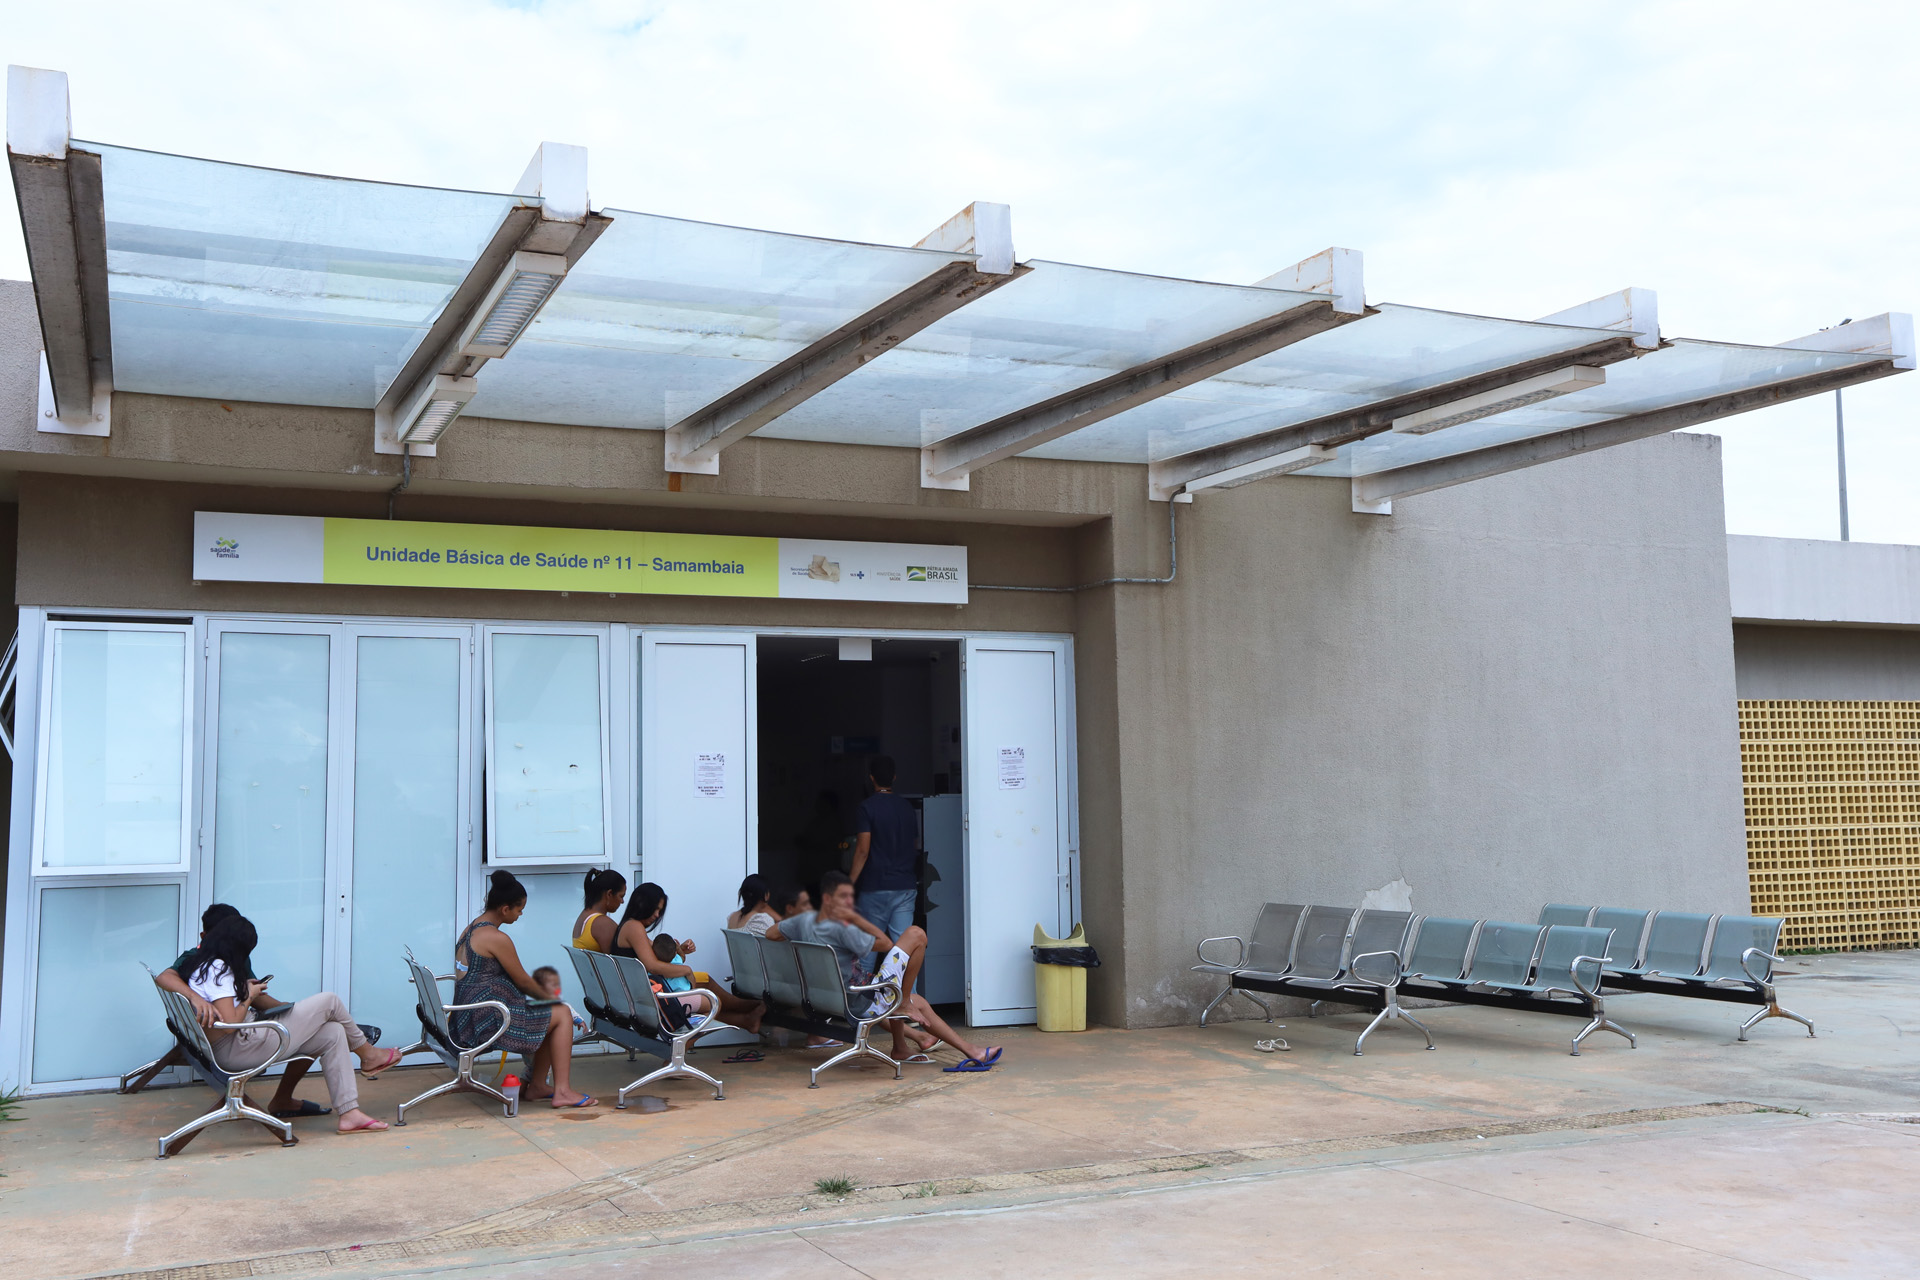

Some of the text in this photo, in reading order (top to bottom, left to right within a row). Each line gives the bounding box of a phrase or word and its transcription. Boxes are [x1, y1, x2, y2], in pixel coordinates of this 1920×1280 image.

[366, 546, 441, 563] Unidade
[446, 549, 504, 566] Básica
[509, 552, 531, 566] de
[535, 552, 588, 568] Saúde
[593, 555, 610, 569] nº
[615, 556, 632, 570] 11
[652, 557, 745, 575] Samambaia
[927, 571, 958, 580] BRASIL
